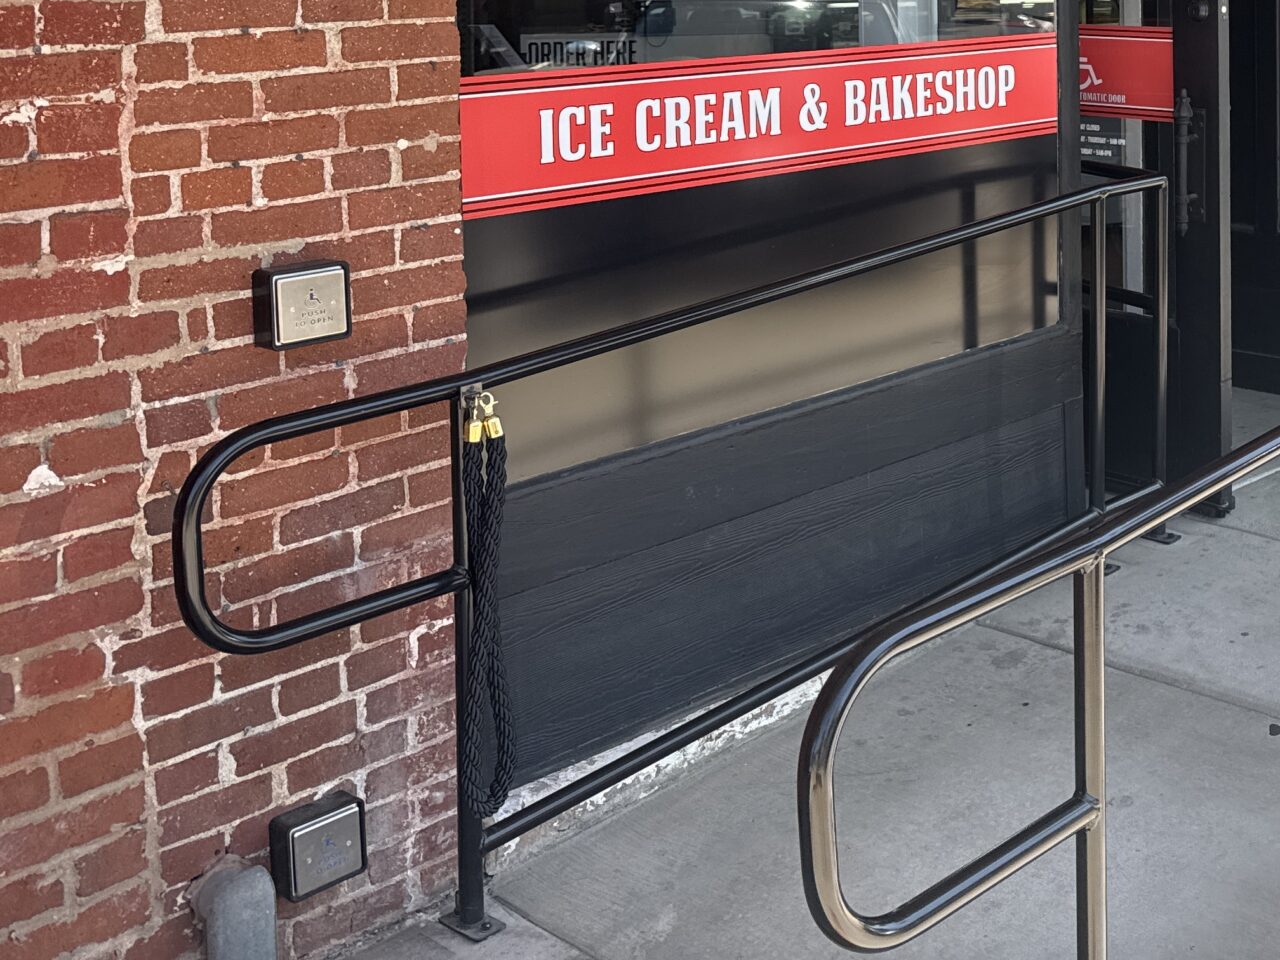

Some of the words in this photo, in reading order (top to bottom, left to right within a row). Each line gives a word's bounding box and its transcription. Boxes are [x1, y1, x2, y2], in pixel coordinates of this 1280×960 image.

[528, 41, 587, 66] ORDER
[593, 40, 638, 65] HERE
[1079, 92, 1107, 103] TOMATIC
[1108, 93, 1126, 104] DOOR
[539, 104, 614, 165] ICE
[635, 87, 782, 152] CREAM
[799, 83, 829, 132] &
[844, 64, 1016, 127] BAKESHOP
[301, 308, 326, 318] PUSH
[310, 315, 334, 325] OPEN
